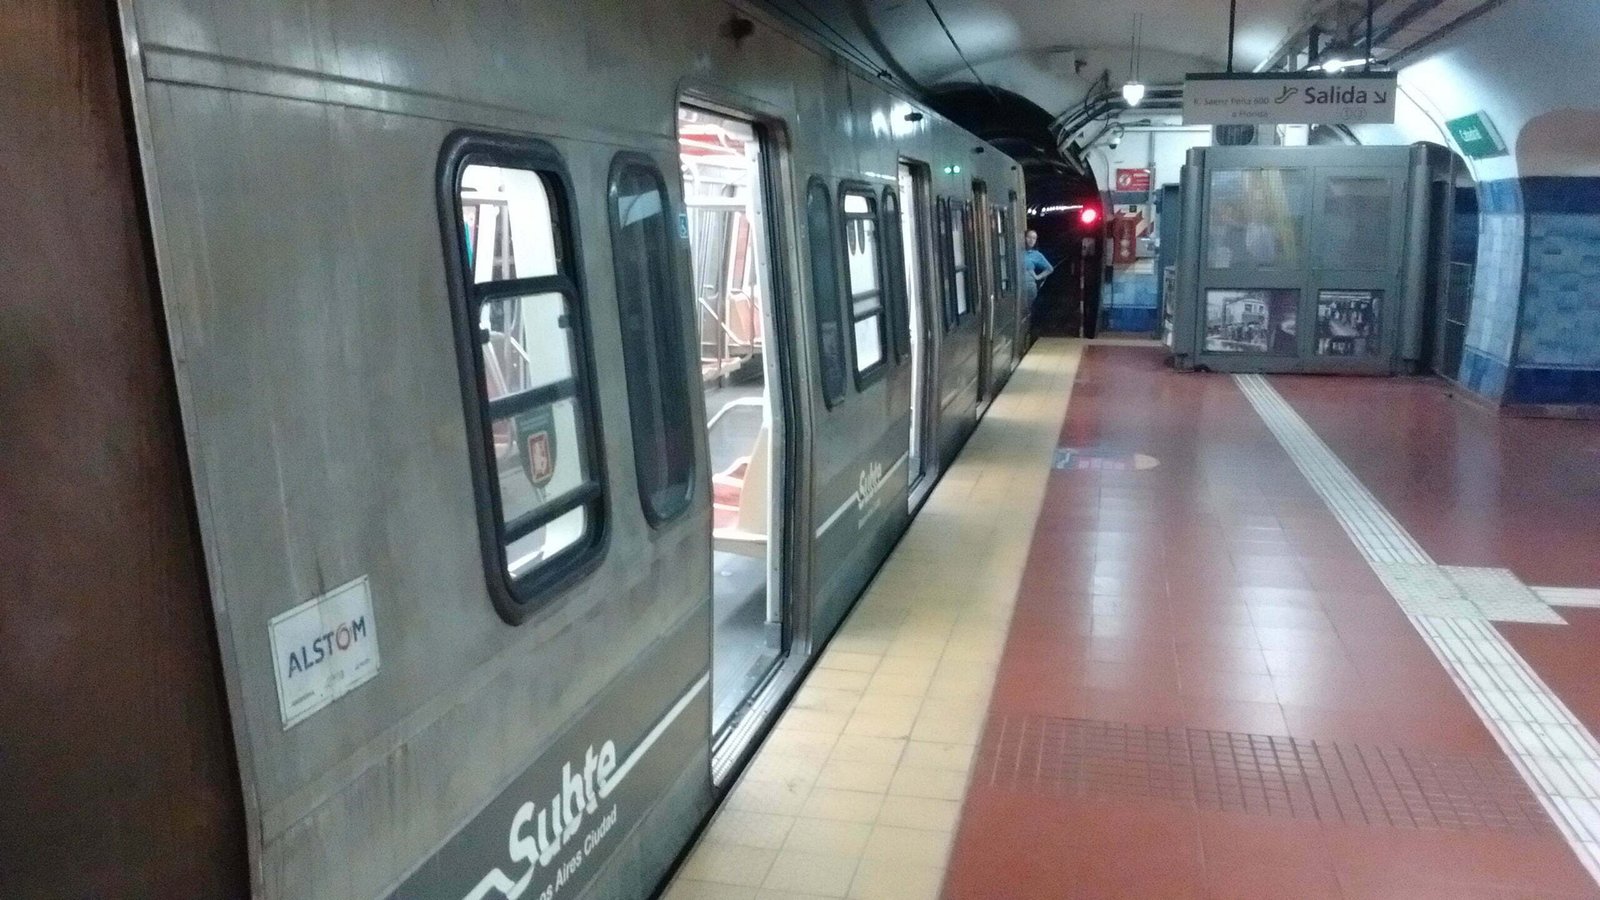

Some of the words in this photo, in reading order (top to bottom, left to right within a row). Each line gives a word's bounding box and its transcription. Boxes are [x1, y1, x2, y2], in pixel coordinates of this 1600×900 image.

[1304, 86, 1367, 104] Salida
[288, 615, 367, 679] ALSTOM
[509, 739, 617, 870] Subte
[555, 850, 582, 893] Aires
[583, 805, 618, 857] Ciudad
